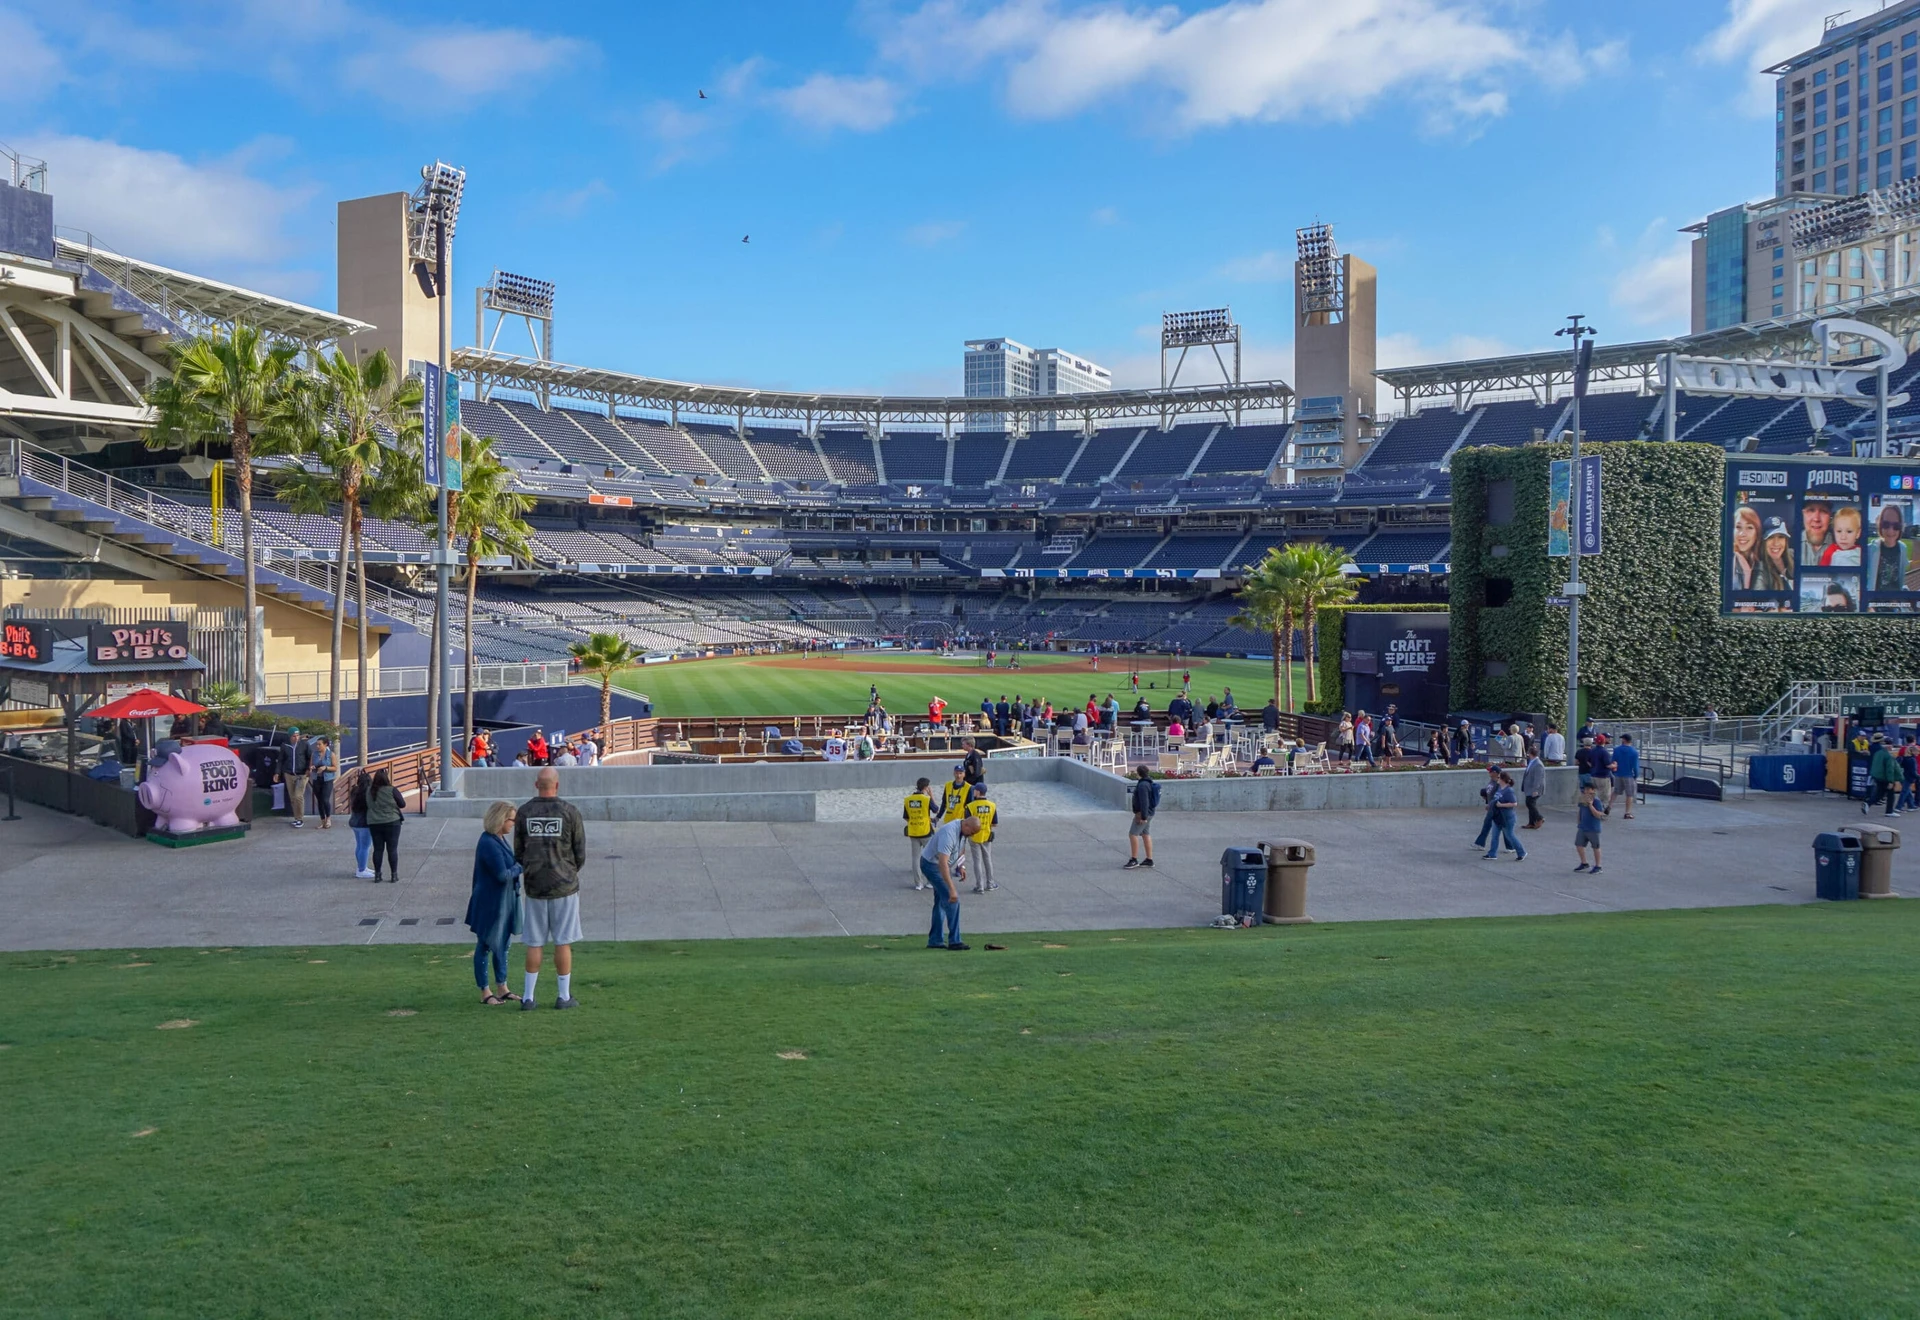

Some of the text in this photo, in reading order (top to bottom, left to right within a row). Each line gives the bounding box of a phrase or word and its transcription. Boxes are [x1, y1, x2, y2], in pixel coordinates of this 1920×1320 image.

[1741, 472, 1784, 484] #SDINHD
[1807, 470, 1858, 491] PADRES
[6, 625, 31, 644] Phil's
[112, 628, 172, 647] Phil's
[1390, 640, 1431, 652] CRAFT
[1396, 652, 1426, 664] PIER
[128, 708, 160, 716] Coca-Cola
[829, 746, 840, 754] 35
[200, 760, 235, 769] STADIUM
[201, 766, 236, 780] FOOD
[203, 778, 238, 793] KING
